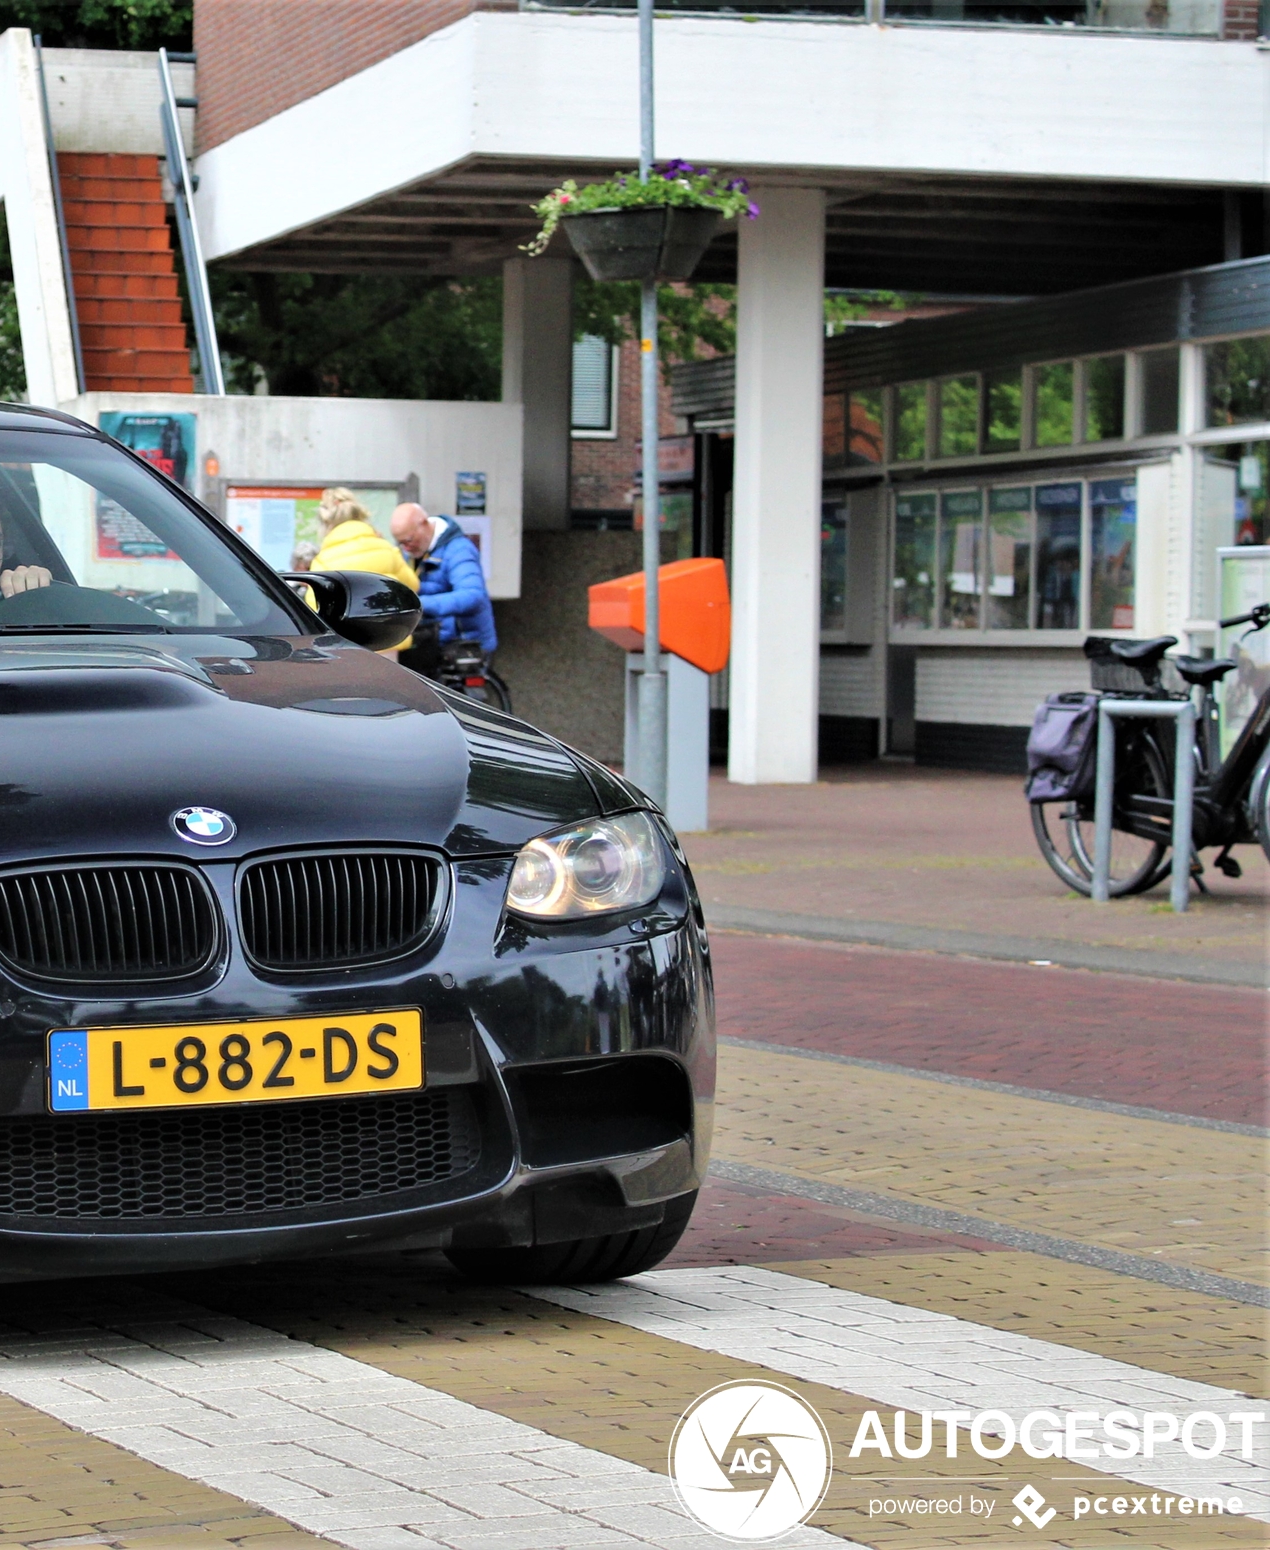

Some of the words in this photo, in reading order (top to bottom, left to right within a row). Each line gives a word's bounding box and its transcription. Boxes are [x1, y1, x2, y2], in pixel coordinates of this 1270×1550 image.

[177, 807, 225, 820] BMW
[111, 1022, 401, 1098] L-882-DS
[58, 1078, 84, 1098] NL
